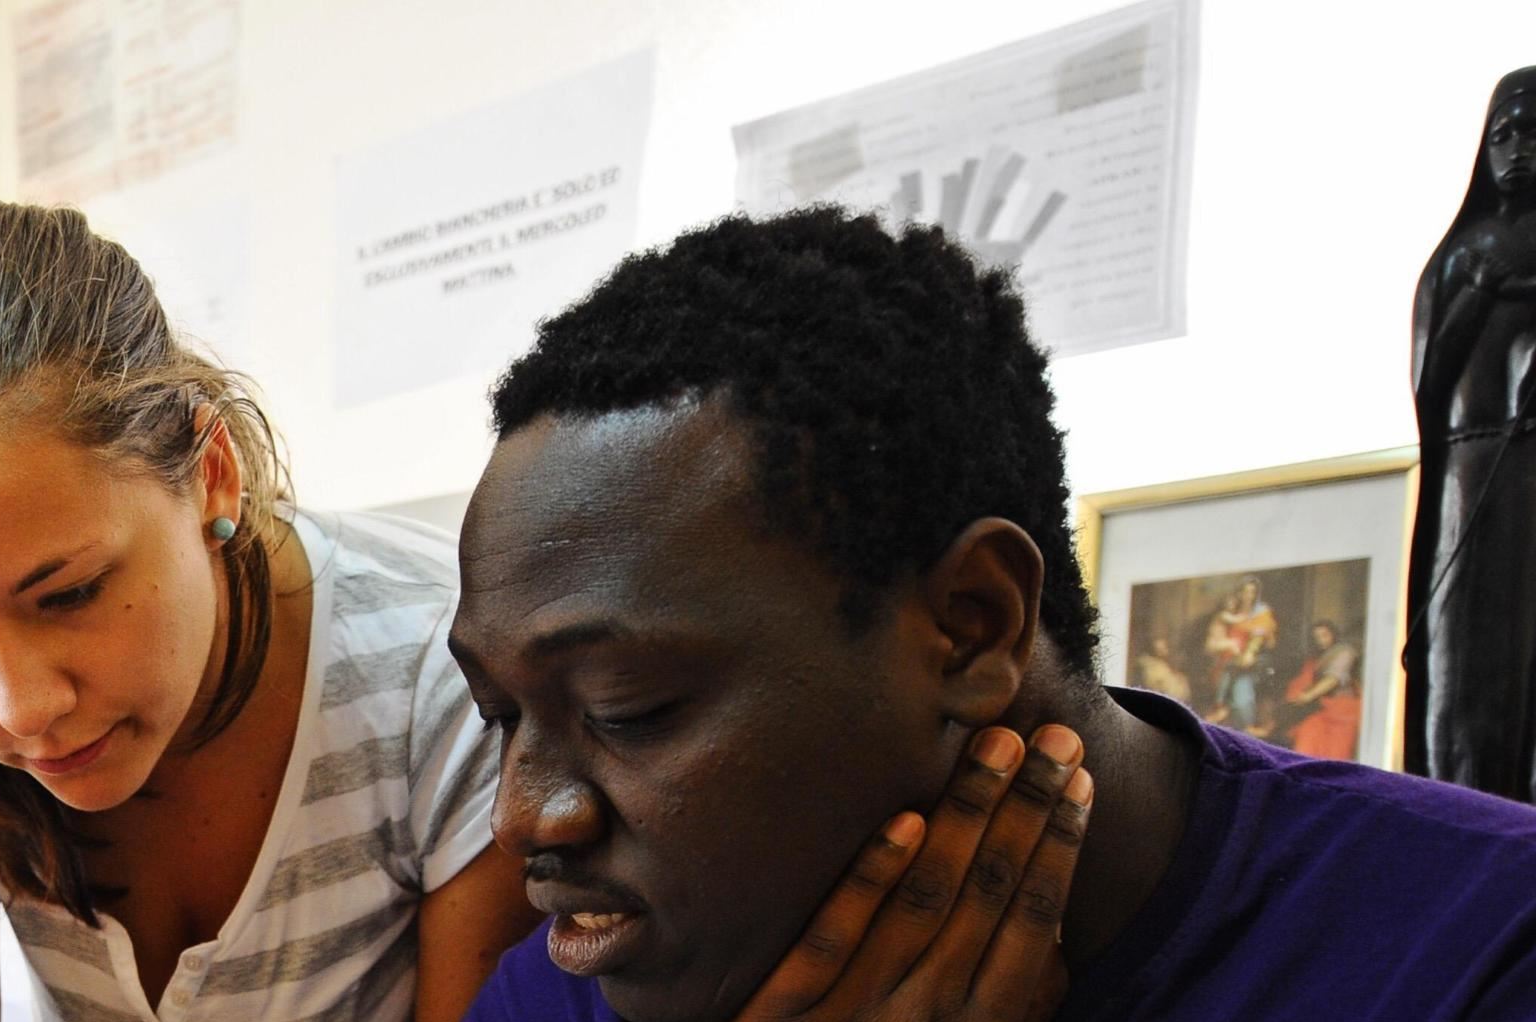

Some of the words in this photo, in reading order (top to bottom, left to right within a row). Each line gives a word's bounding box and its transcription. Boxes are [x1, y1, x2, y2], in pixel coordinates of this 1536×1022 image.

[372, 226, 432, 255] CAMBIO
[435, 197, 529, 236] BIANCHERIA
[551, 174, 597, 203] SOLO
[599, 163, 623, 189] ED
[363, 237, 494, 288] ESCLUSIVAMENTE
